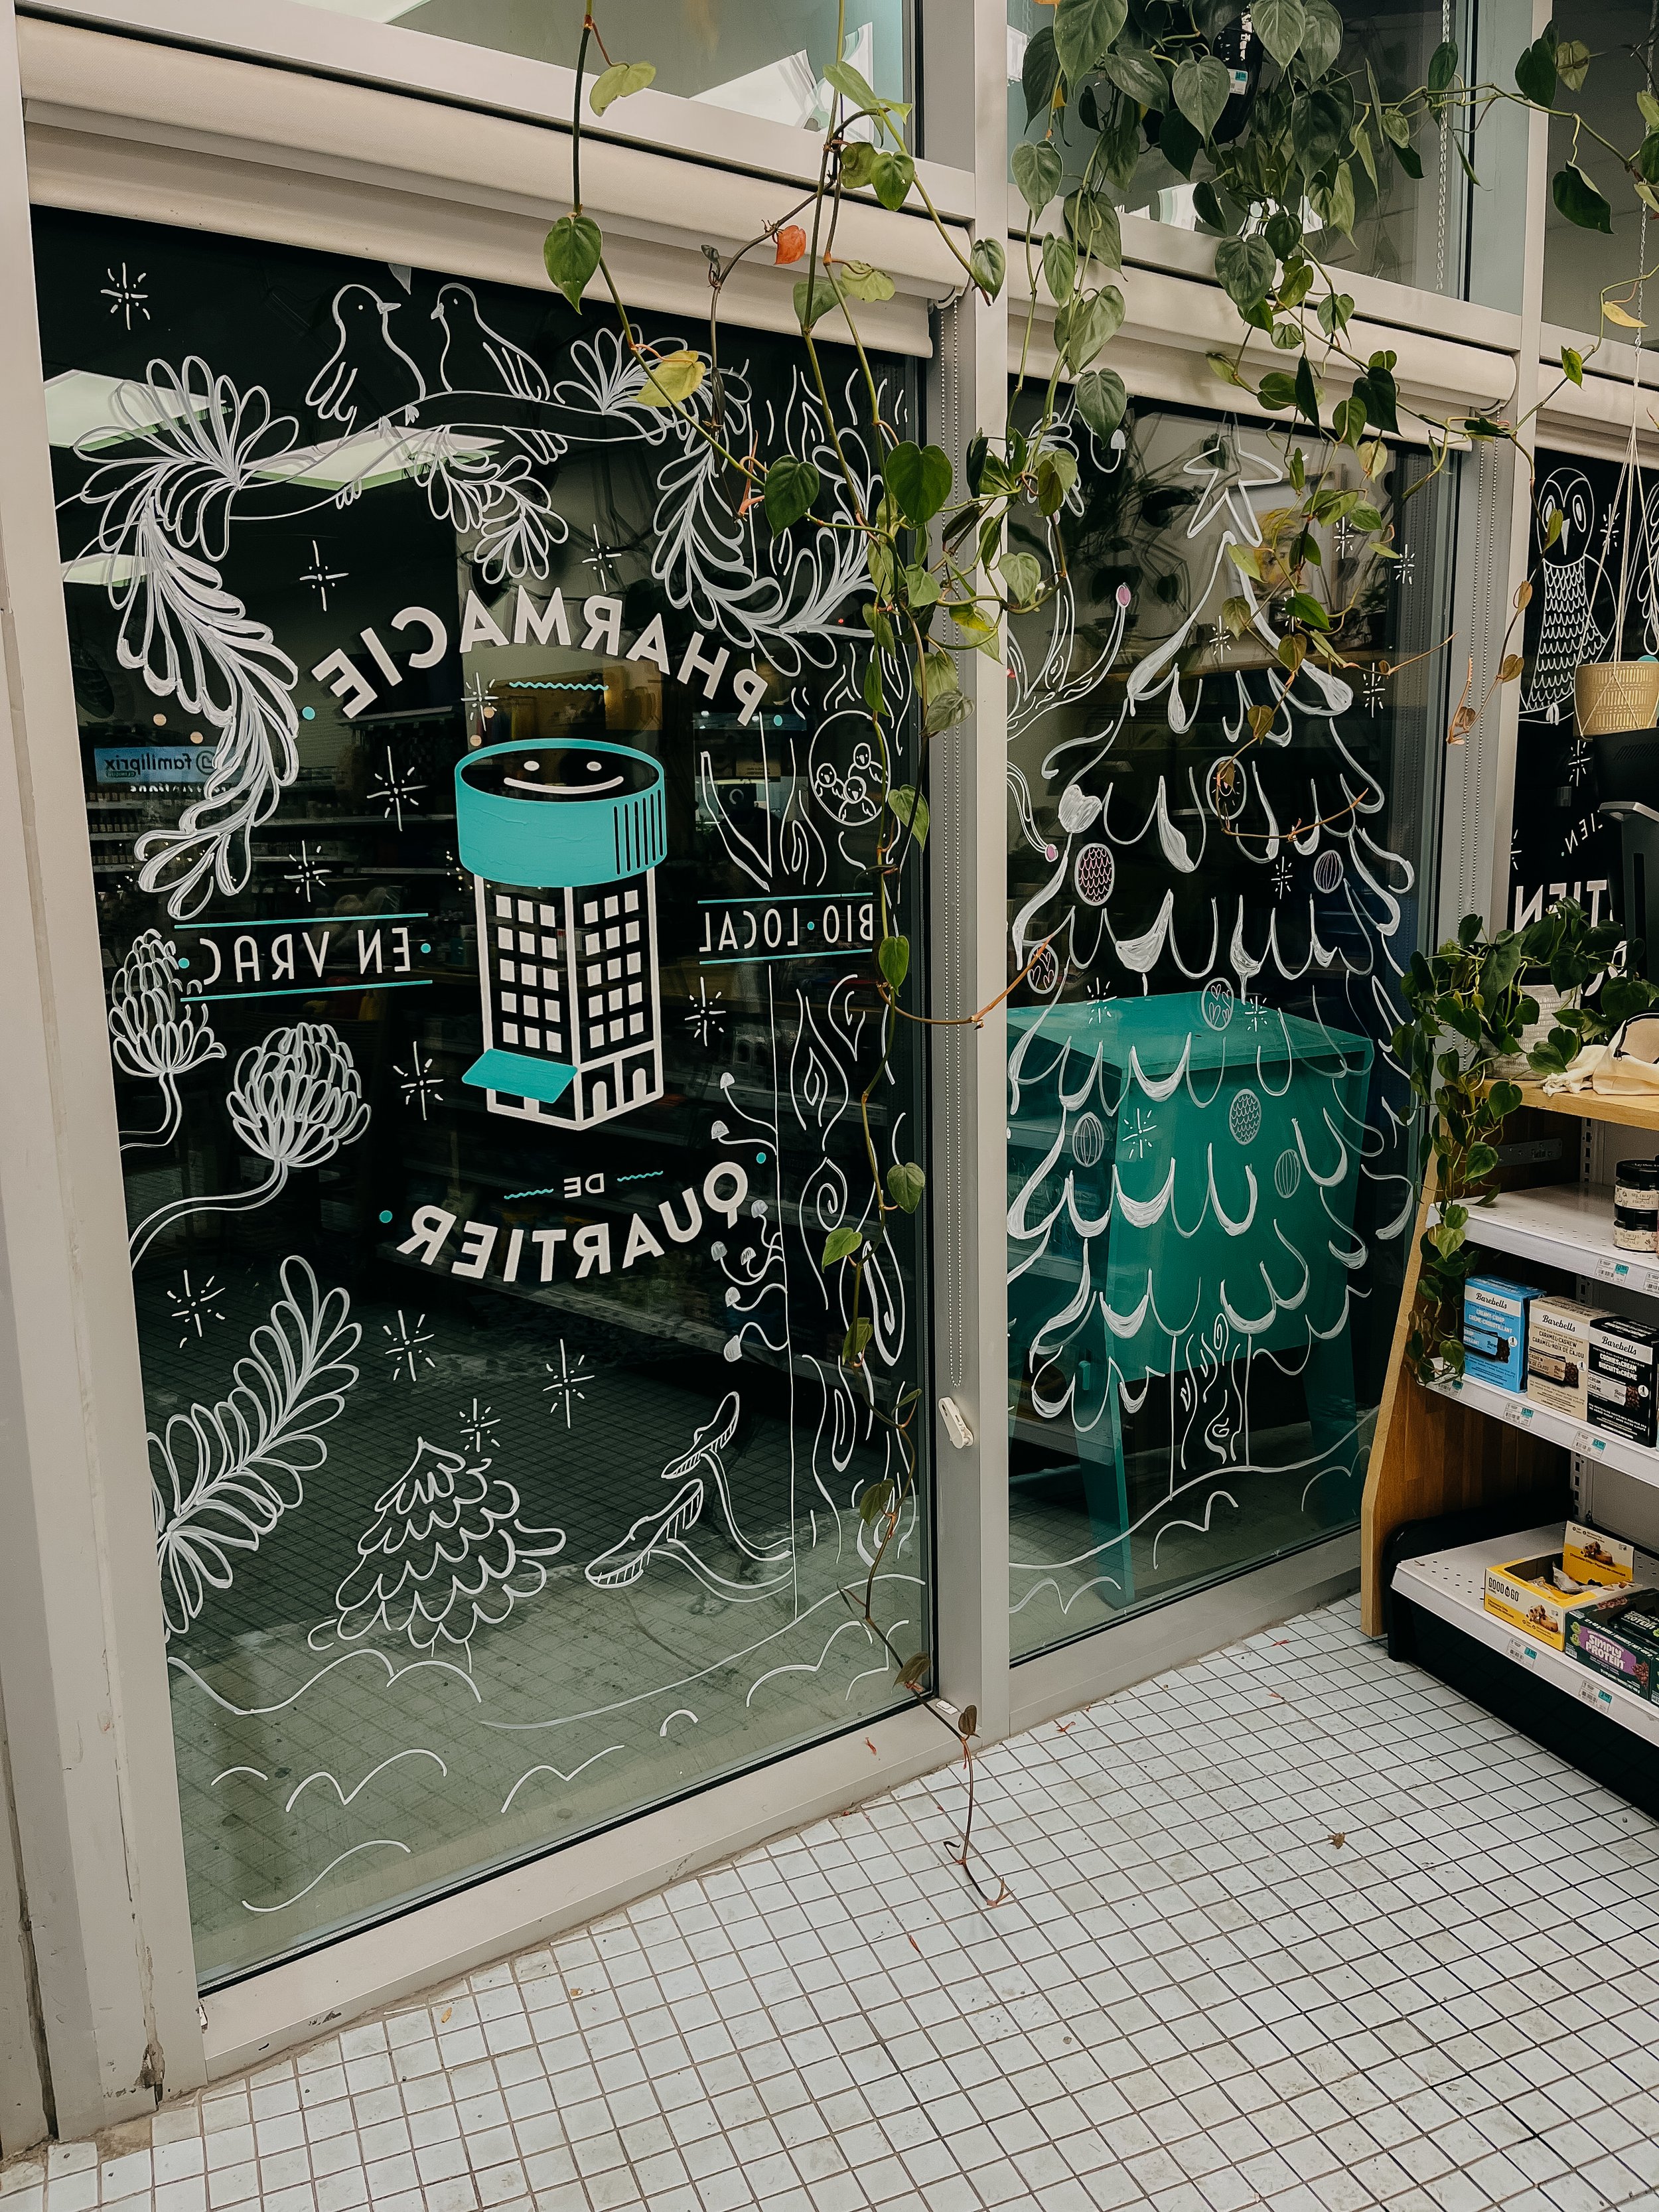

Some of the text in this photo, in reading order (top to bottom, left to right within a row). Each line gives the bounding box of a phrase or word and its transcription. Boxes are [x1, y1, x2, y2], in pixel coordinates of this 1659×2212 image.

[1476, 1292, 1507, 1309] Barebells
[1542, 1314, 1576, 1332] Barebells
[1569, 1349, 1585, 1359] CAJOU
[1601, 1336, 1637, 1355] Barebells
[1488, 1577, 1519, 1601] GOOD GO
[1585, 1641, 1624, 1670] PROTEIN
[1589, 1634, 1622, 1659] SIMPLY
